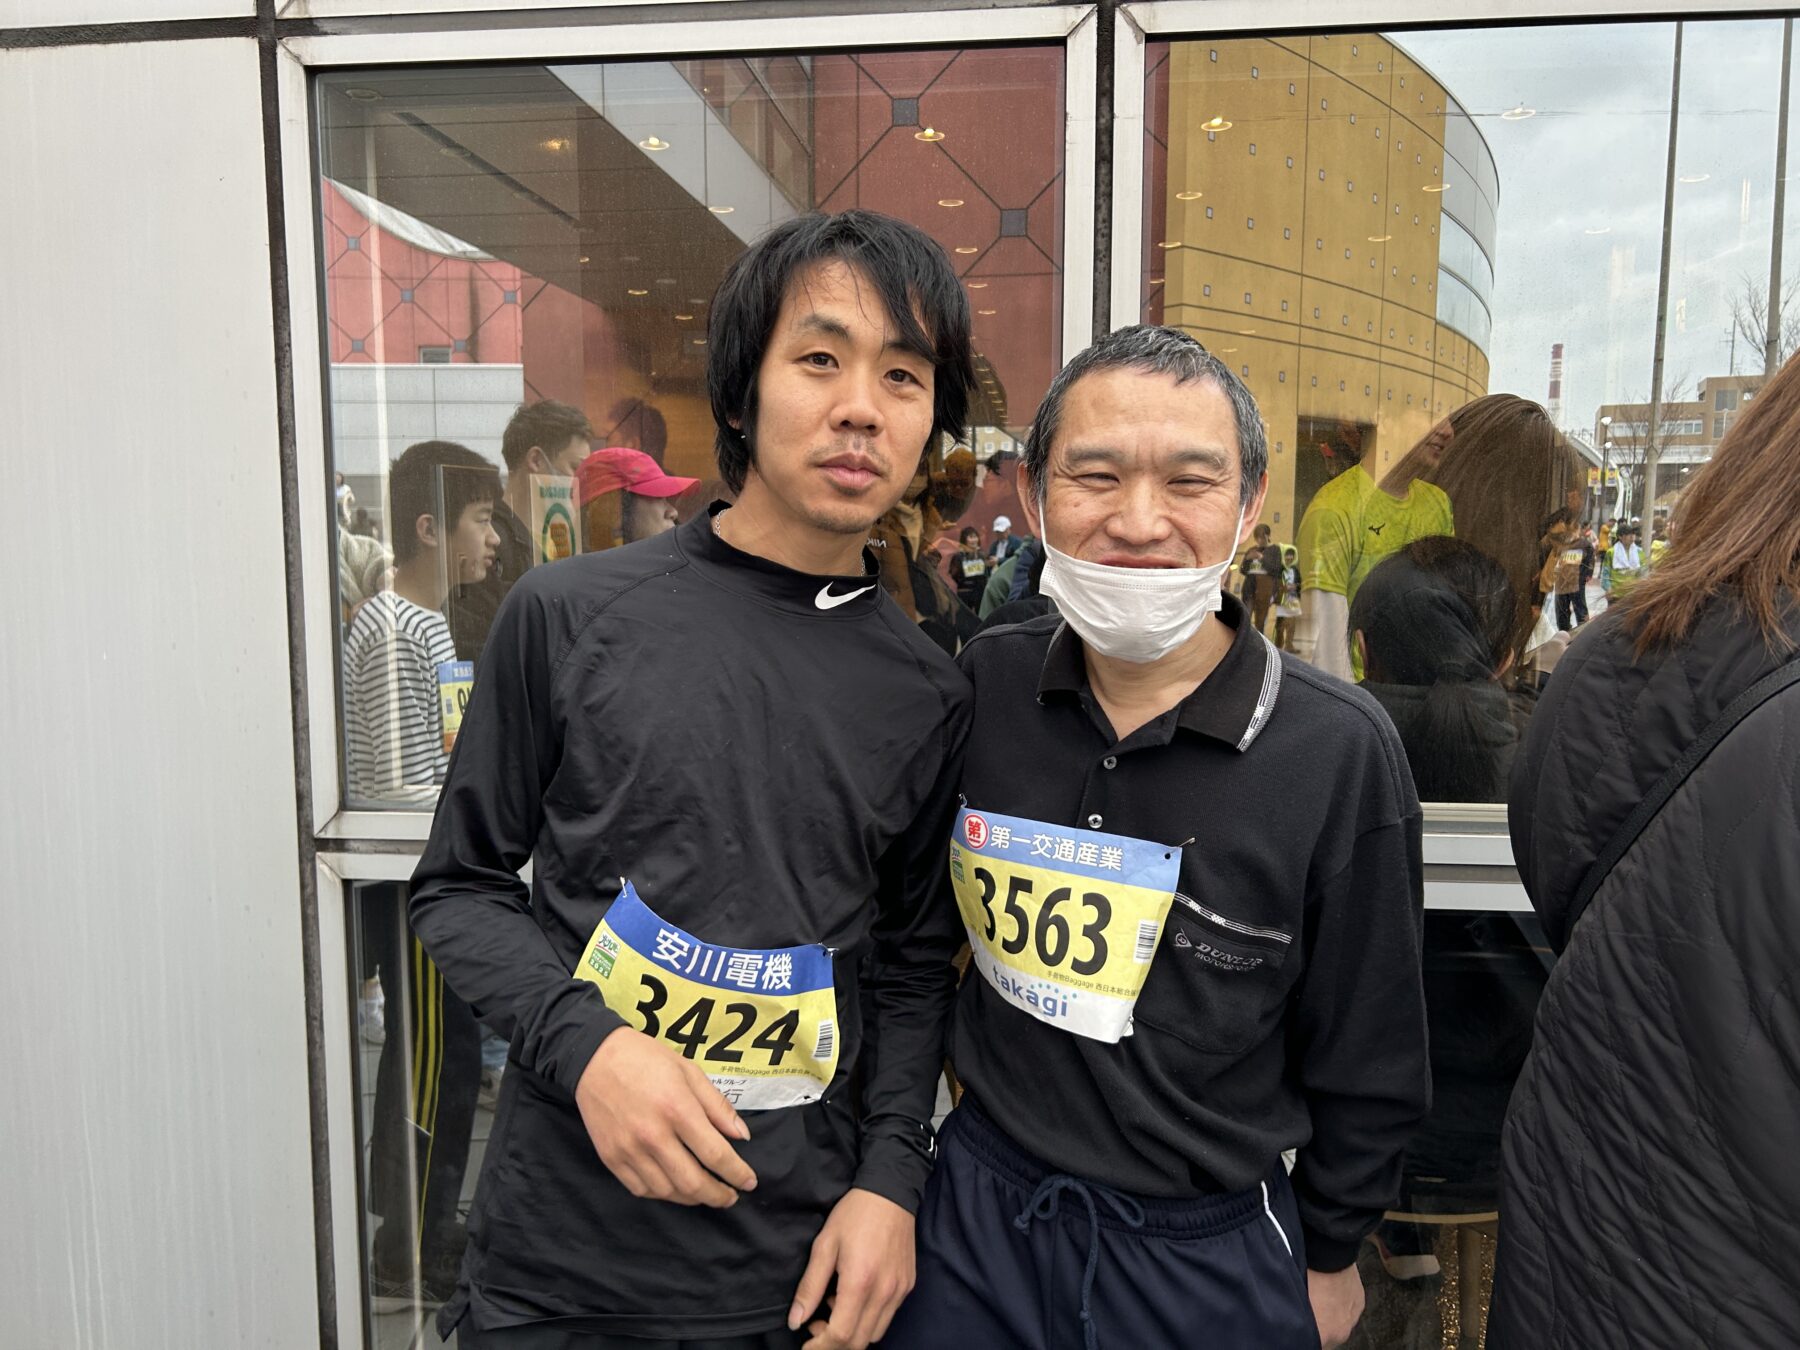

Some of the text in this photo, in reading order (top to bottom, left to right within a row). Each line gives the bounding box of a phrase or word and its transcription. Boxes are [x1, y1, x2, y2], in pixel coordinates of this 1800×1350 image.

[990, 825, 1124, 872] 第一交通産業
[974, 867, 1113, 976] 3563
[652, 928, 793, 990] 安川電機
[635, 973, 800, 1066] 3424
[992, 965, 1069, 1018] takagi
